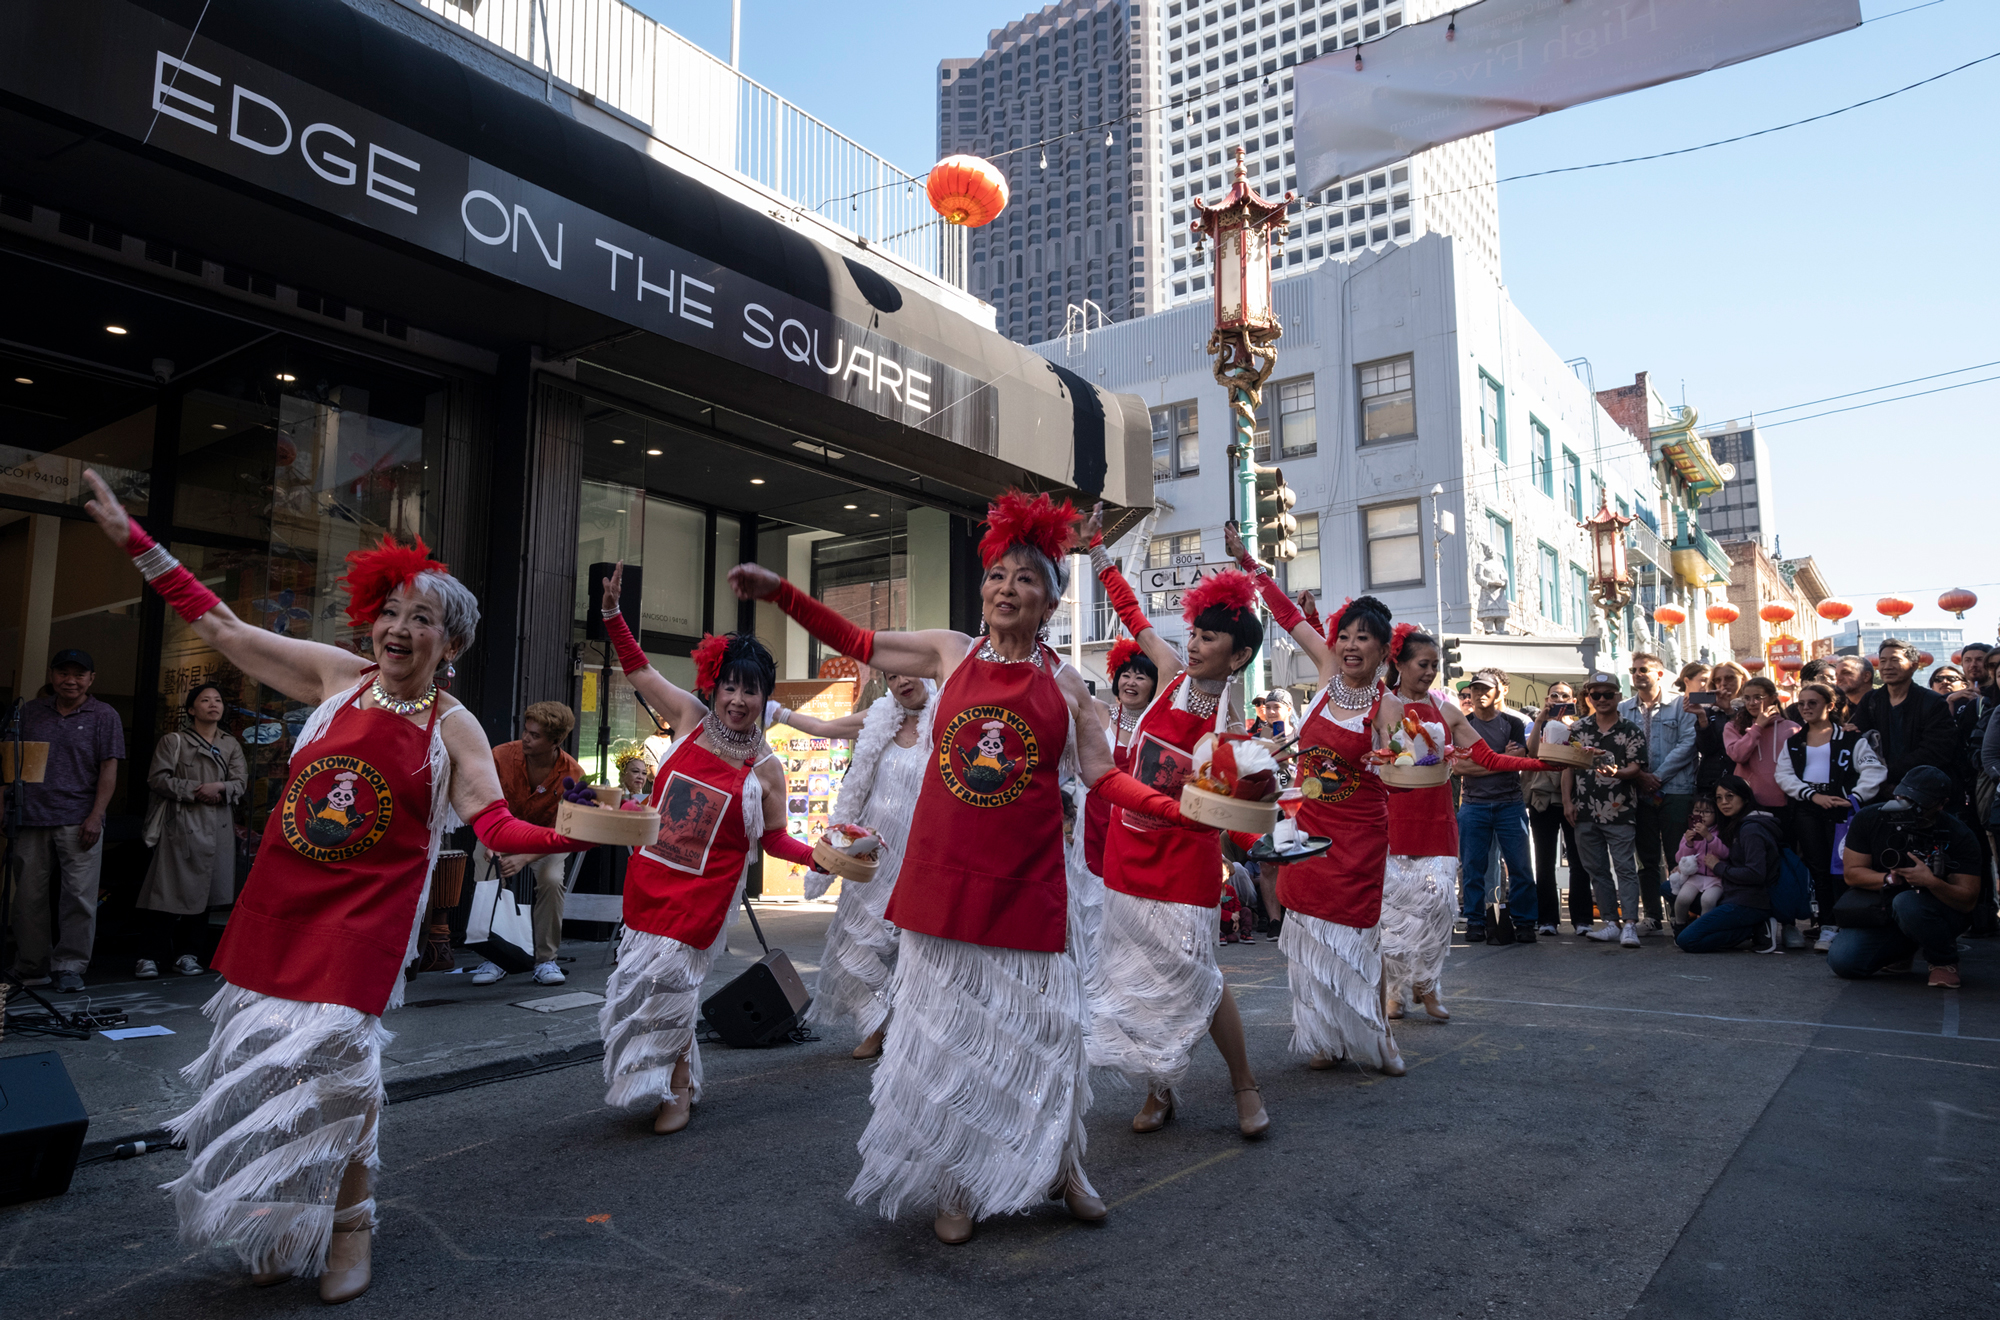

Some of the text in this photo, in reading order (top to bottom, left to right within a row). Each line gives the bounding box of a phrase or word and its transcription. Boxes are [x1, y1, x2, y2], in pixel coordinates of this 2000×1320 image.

[152, 50, 932, 414] EDGE ON THE SQUARE
[34, 471, 69, 487] 94108
[1175, 555, 1193, 564] 800
[641, 612, 668, 622] ANCISCO
[672, 616, 688, 625] 94108
[792, 700, 811, 709] High
[811, 699, 828, 708] Five
[941, 706, 1038, 776] CHINATOWN WOK CLUB
[1837, 749, 1851, 767] C
[940, 762, 1025, 807] SAN FRANCISCO
[286, 756, 392, 833] CHINATOWN WOK CLUB
[1317, 786, 1355, 802] ANCISCO
[283, 811, 375, 861] SAN FRANCISCO
